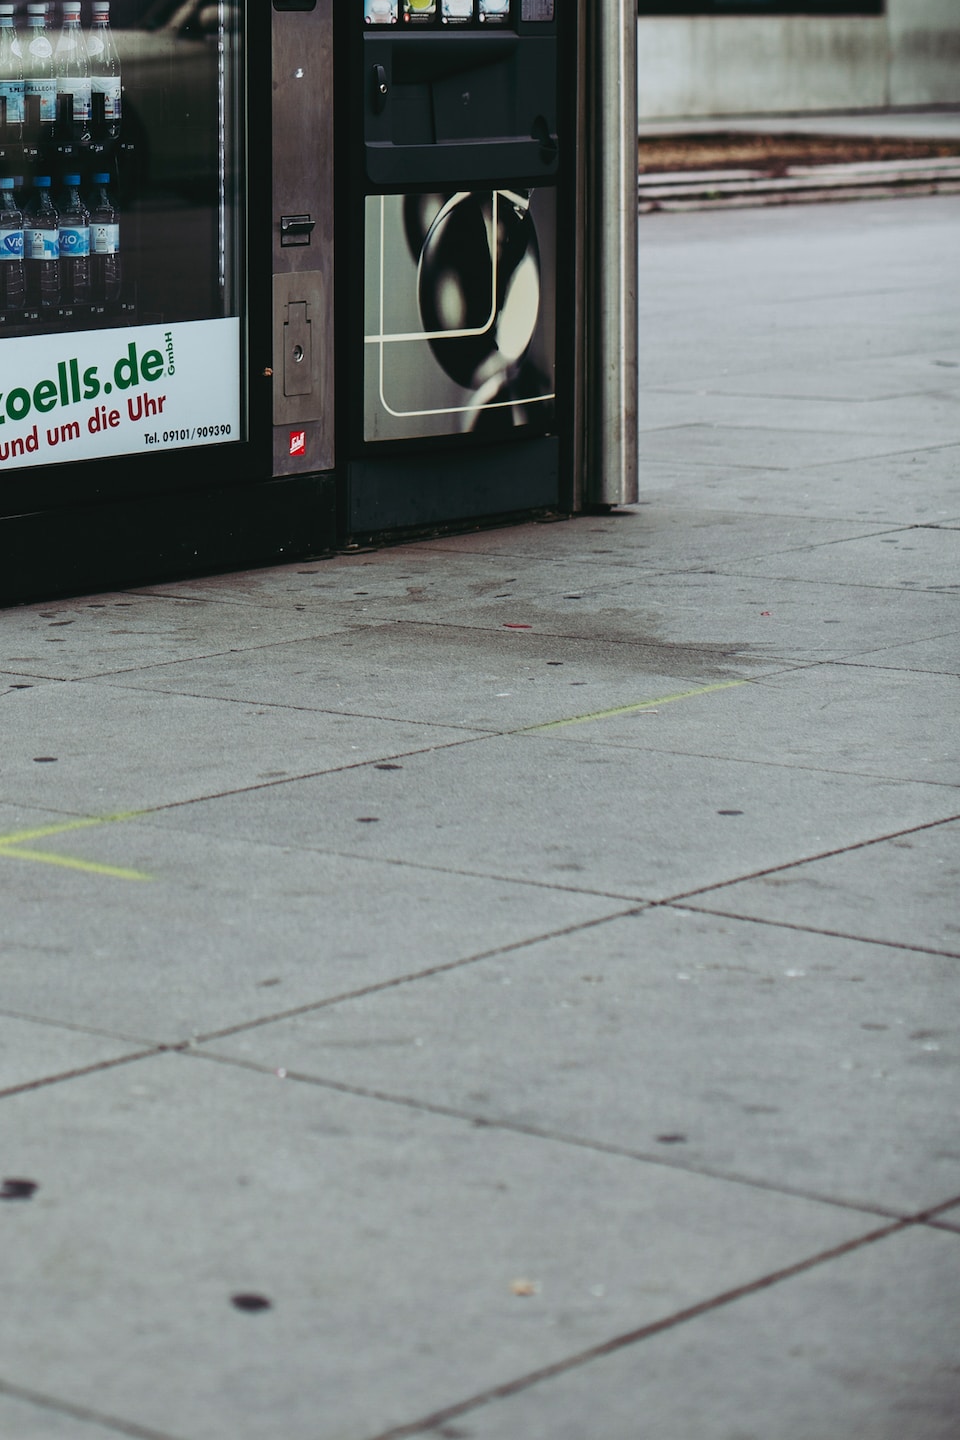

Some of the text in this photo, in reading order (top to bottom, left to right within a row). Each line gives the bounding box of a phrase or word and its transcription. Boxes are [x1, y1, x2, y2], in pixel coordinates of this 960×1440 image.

[164, 331, 175, 376] GmbH
[47, 421, 80, 446] um
[88, 405, 120, 433] die
[127, 392, 166, 421] Uhr
[144, 433, 160, 445] Tel.
